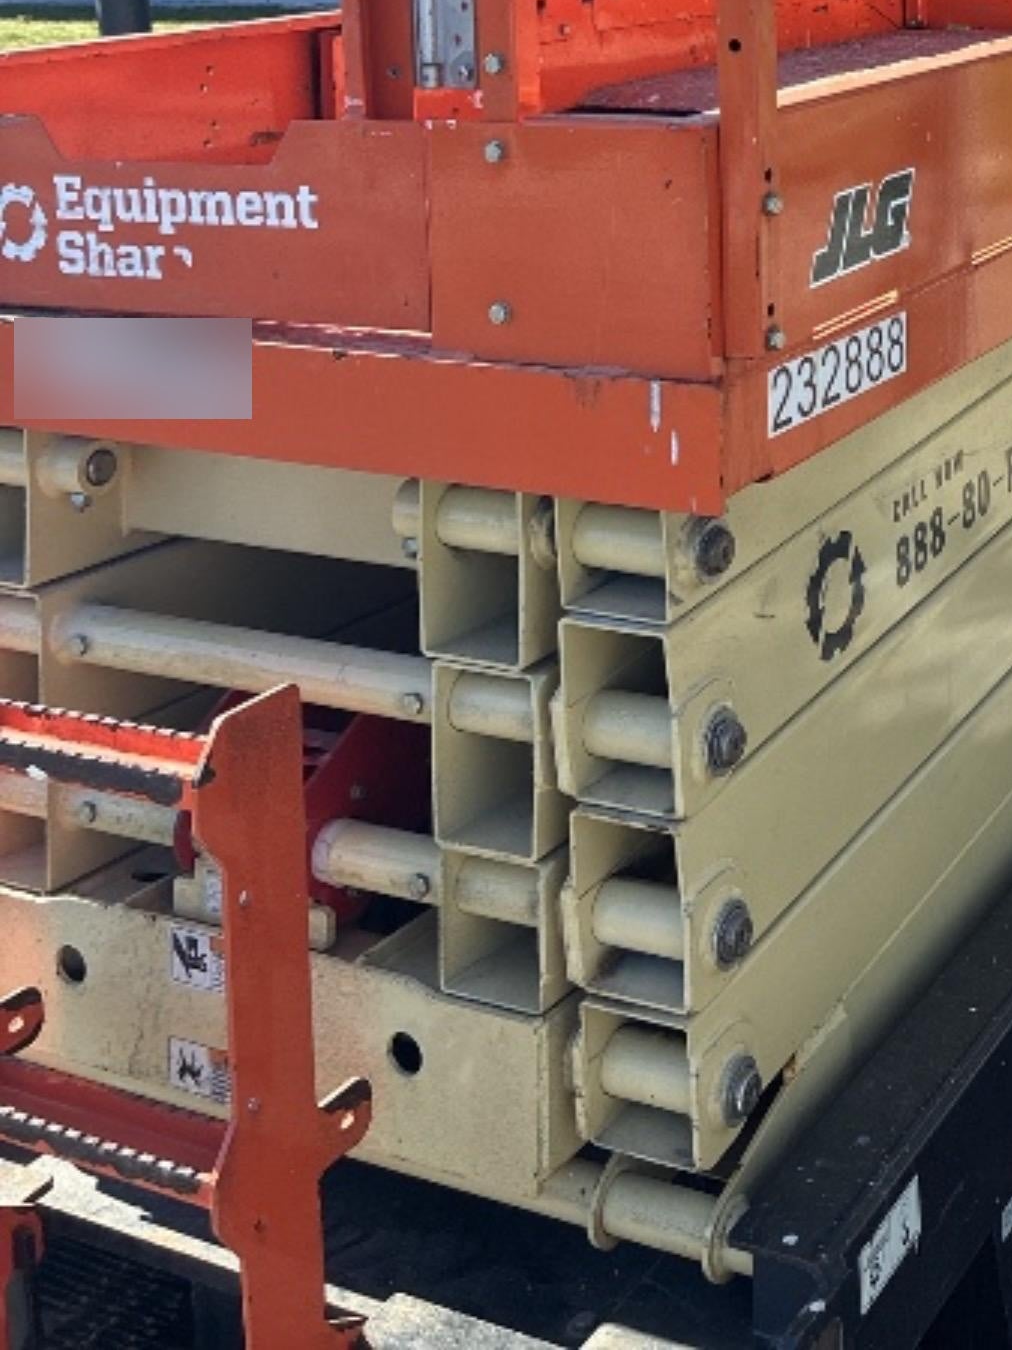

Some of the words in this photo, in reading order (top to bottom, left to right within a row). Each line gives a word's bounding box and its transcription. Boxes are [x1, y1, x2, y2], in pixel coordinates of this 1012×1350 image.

[53, 174, 319, 235] Equipment
[809, 167, 915, 289] JLG
[57, 230, 193, 280] Shar
[771, 317, 905, 432] 232888
[893, 479, 928, 522] CALL
